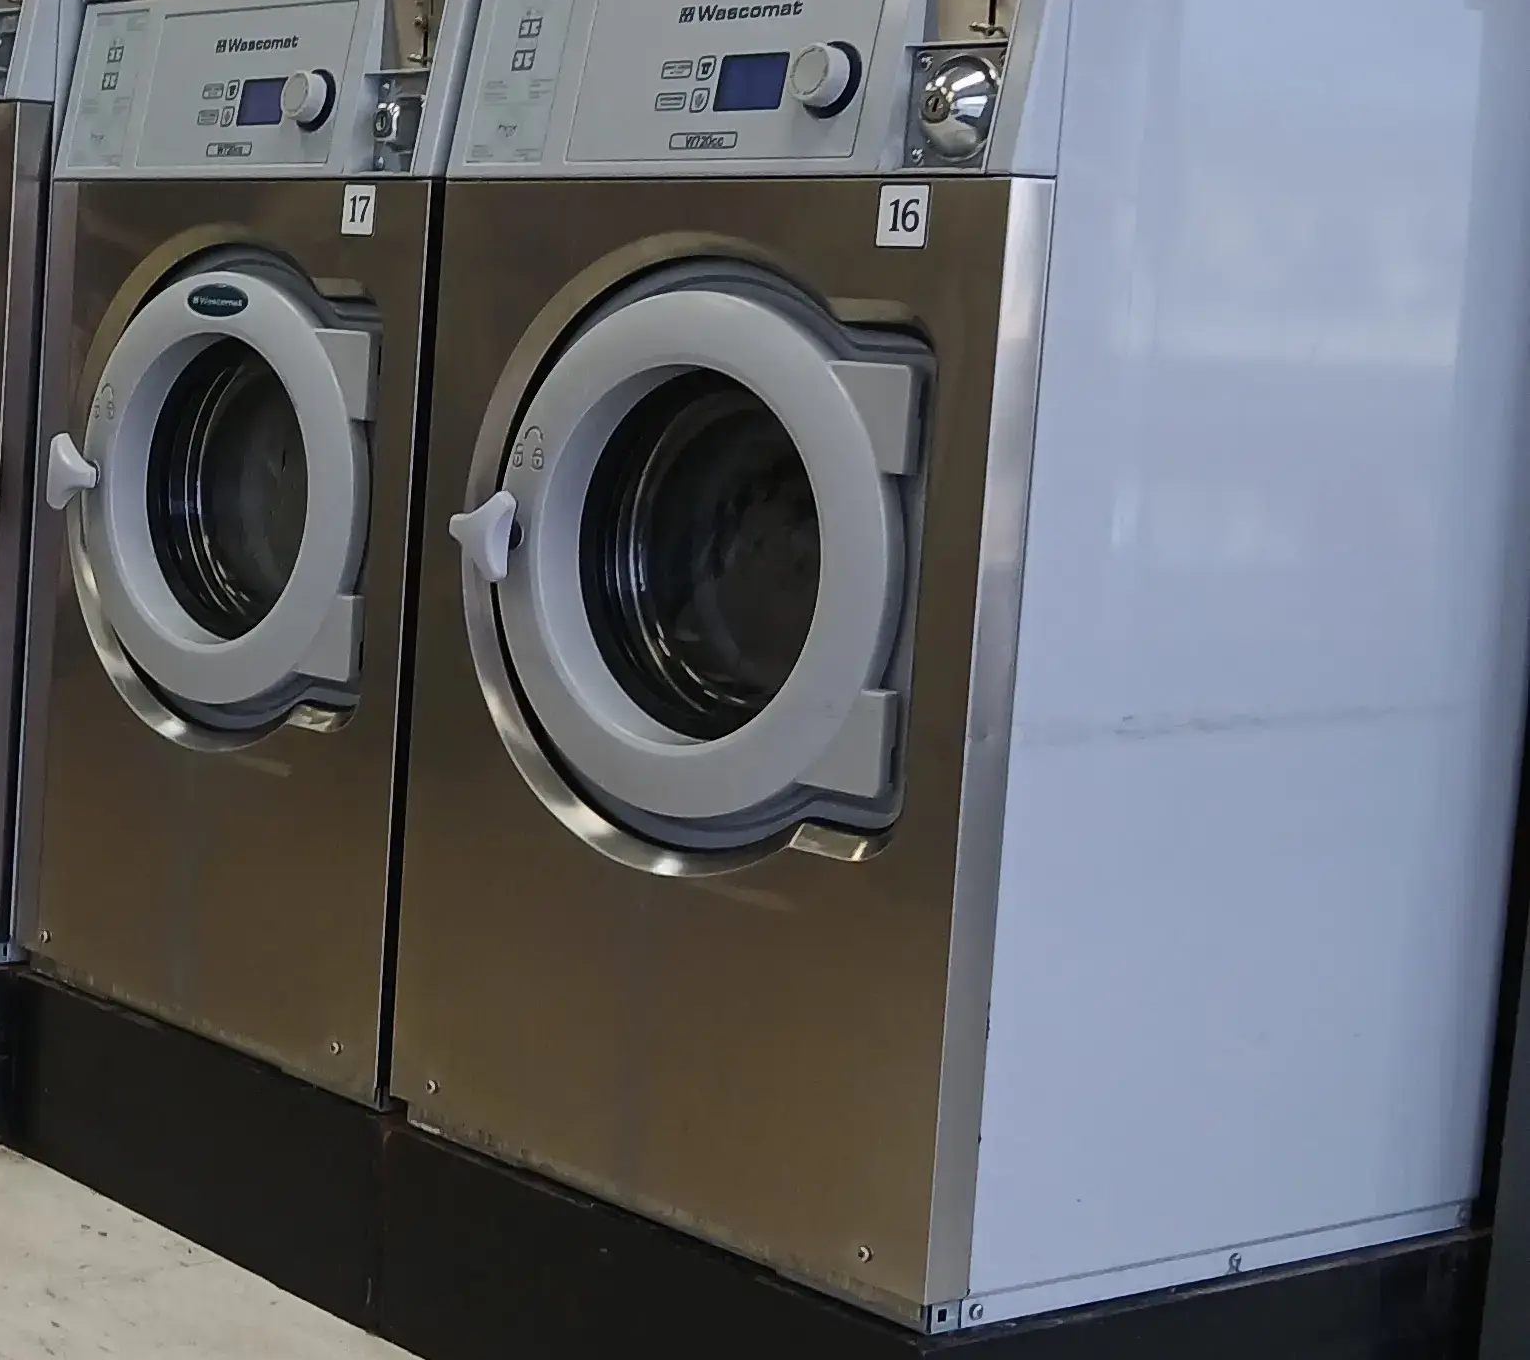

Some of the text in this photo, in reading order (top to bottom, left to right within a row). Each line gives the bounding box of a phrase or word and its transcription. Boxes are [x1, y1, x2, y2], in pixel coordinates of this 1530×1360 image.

[698, 0, 803, 21] Wascomat
[228, 35, 299, 53] Wascomat
[349, 195, 371, 223] 17
[889, 198, 920, 232] 16
